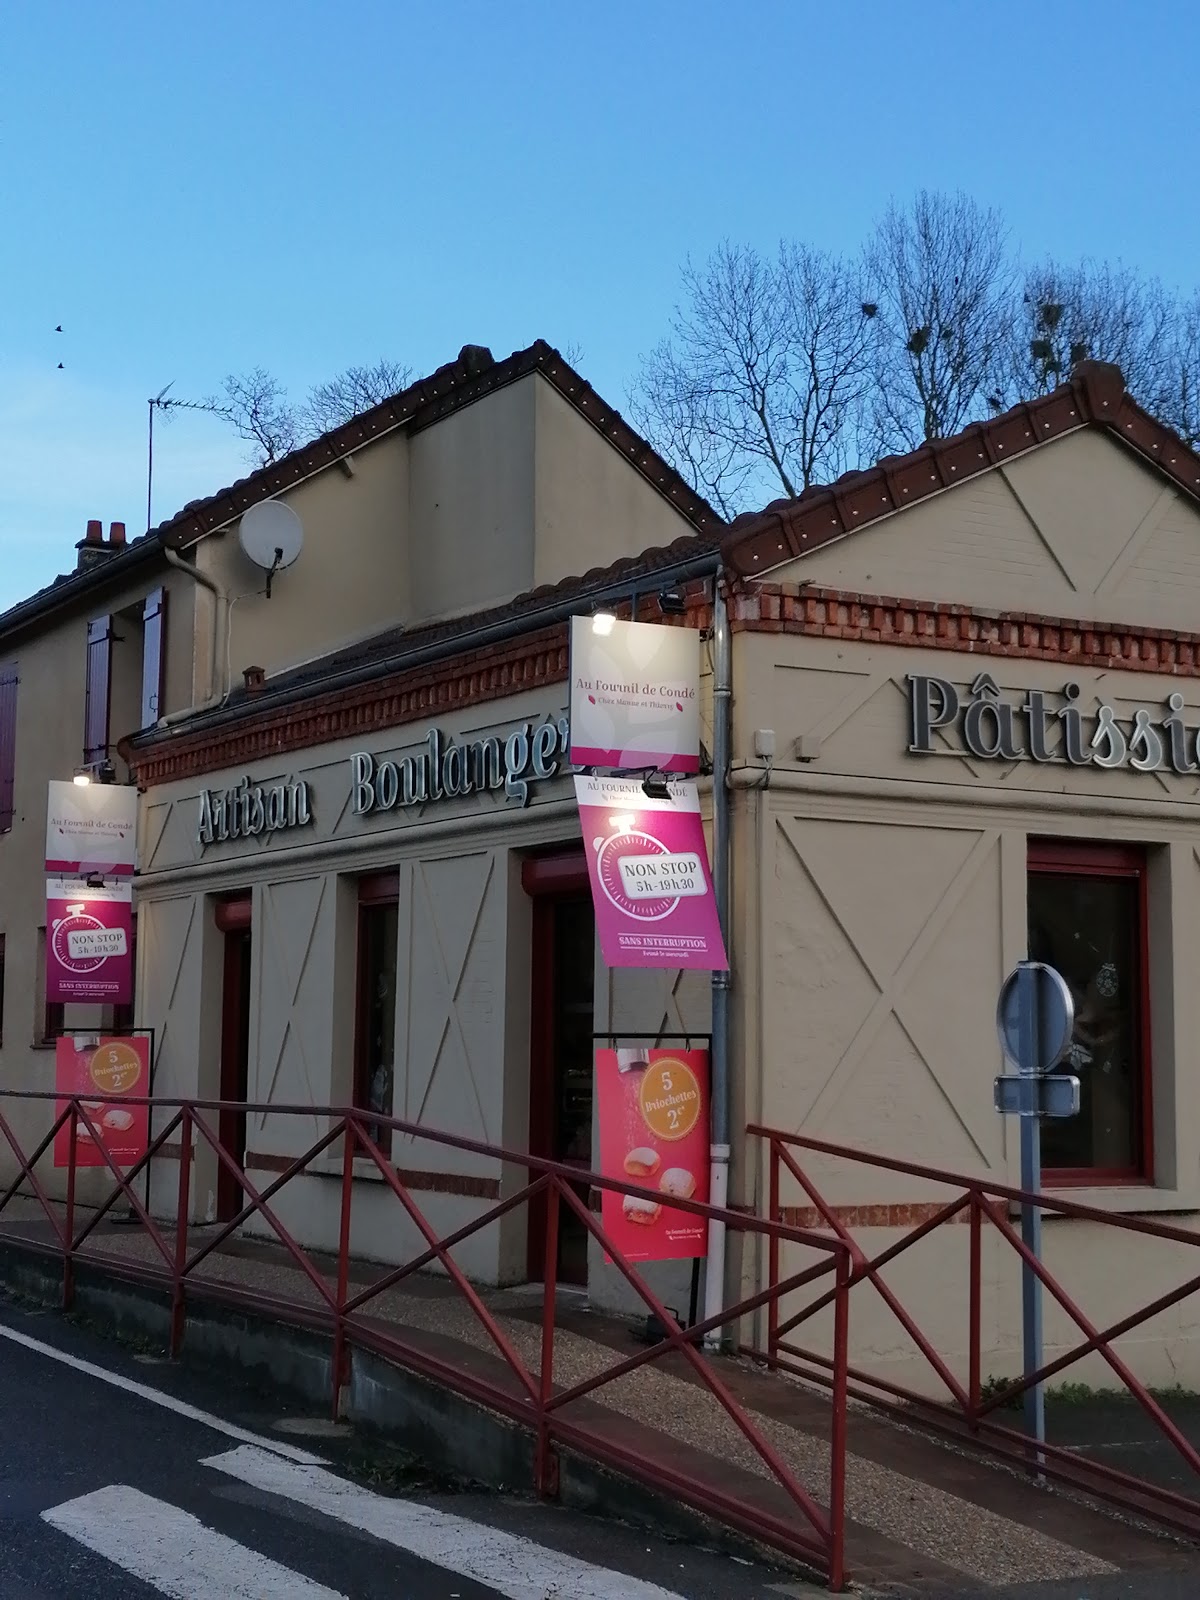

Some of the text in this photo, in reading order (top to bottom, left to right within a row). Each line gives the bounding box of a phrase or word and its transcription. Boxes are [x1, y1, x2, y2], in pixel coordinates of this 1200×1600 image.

[576, 678, 695, 699] Au Fournil de Condé
[906, 671, 1200, 774] Pâtissi
[587, 782, 688, 797] AU FOURNIL NDÉ
[197, 775, 310, 844] Artisan
[625, 861, 697, 877] NON STOP
[72, 933, 123, 945] NON STOP
[619, 936, 707, 948] SANS INTERRUPTION
[109, 1050, 119, 1063] 5
[661, 1071, 673, 1091] 5
[645, 1089, 697, 1112] Briochettes
